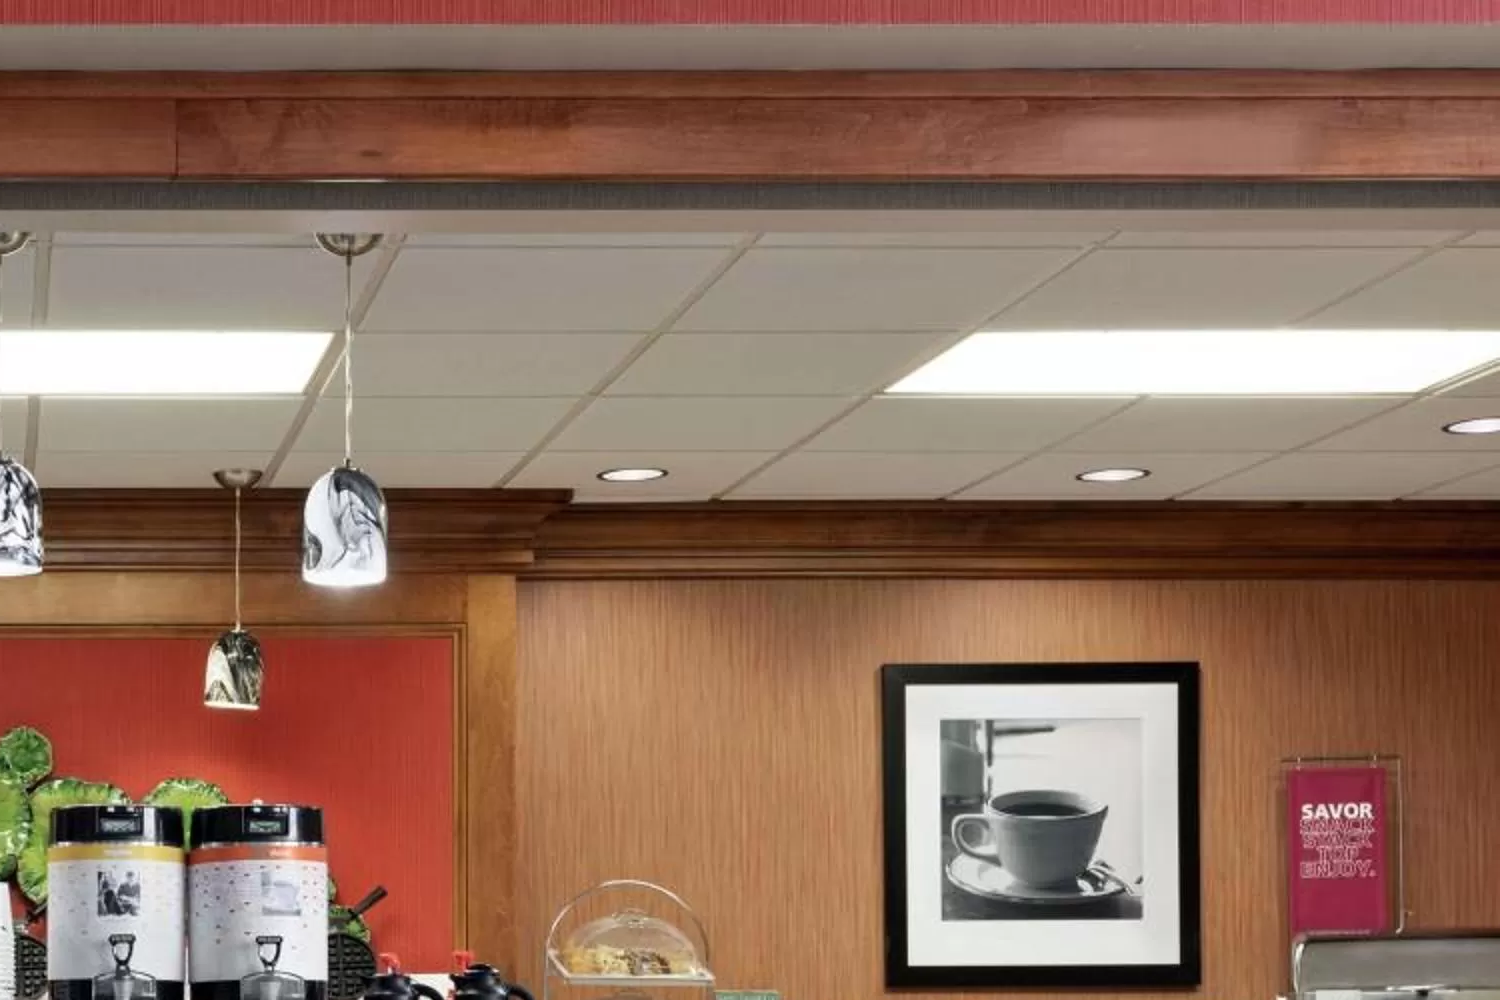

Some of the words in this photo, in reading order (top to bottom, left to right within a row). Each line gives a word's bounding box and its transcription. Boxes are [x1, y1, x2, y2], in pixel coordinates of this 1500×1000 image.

[1301, 803, 1374, 820] SAVOR
[1300, 818, 1375, 834] SNACK
[1300, 860, 1377, 879] ENJOY.
